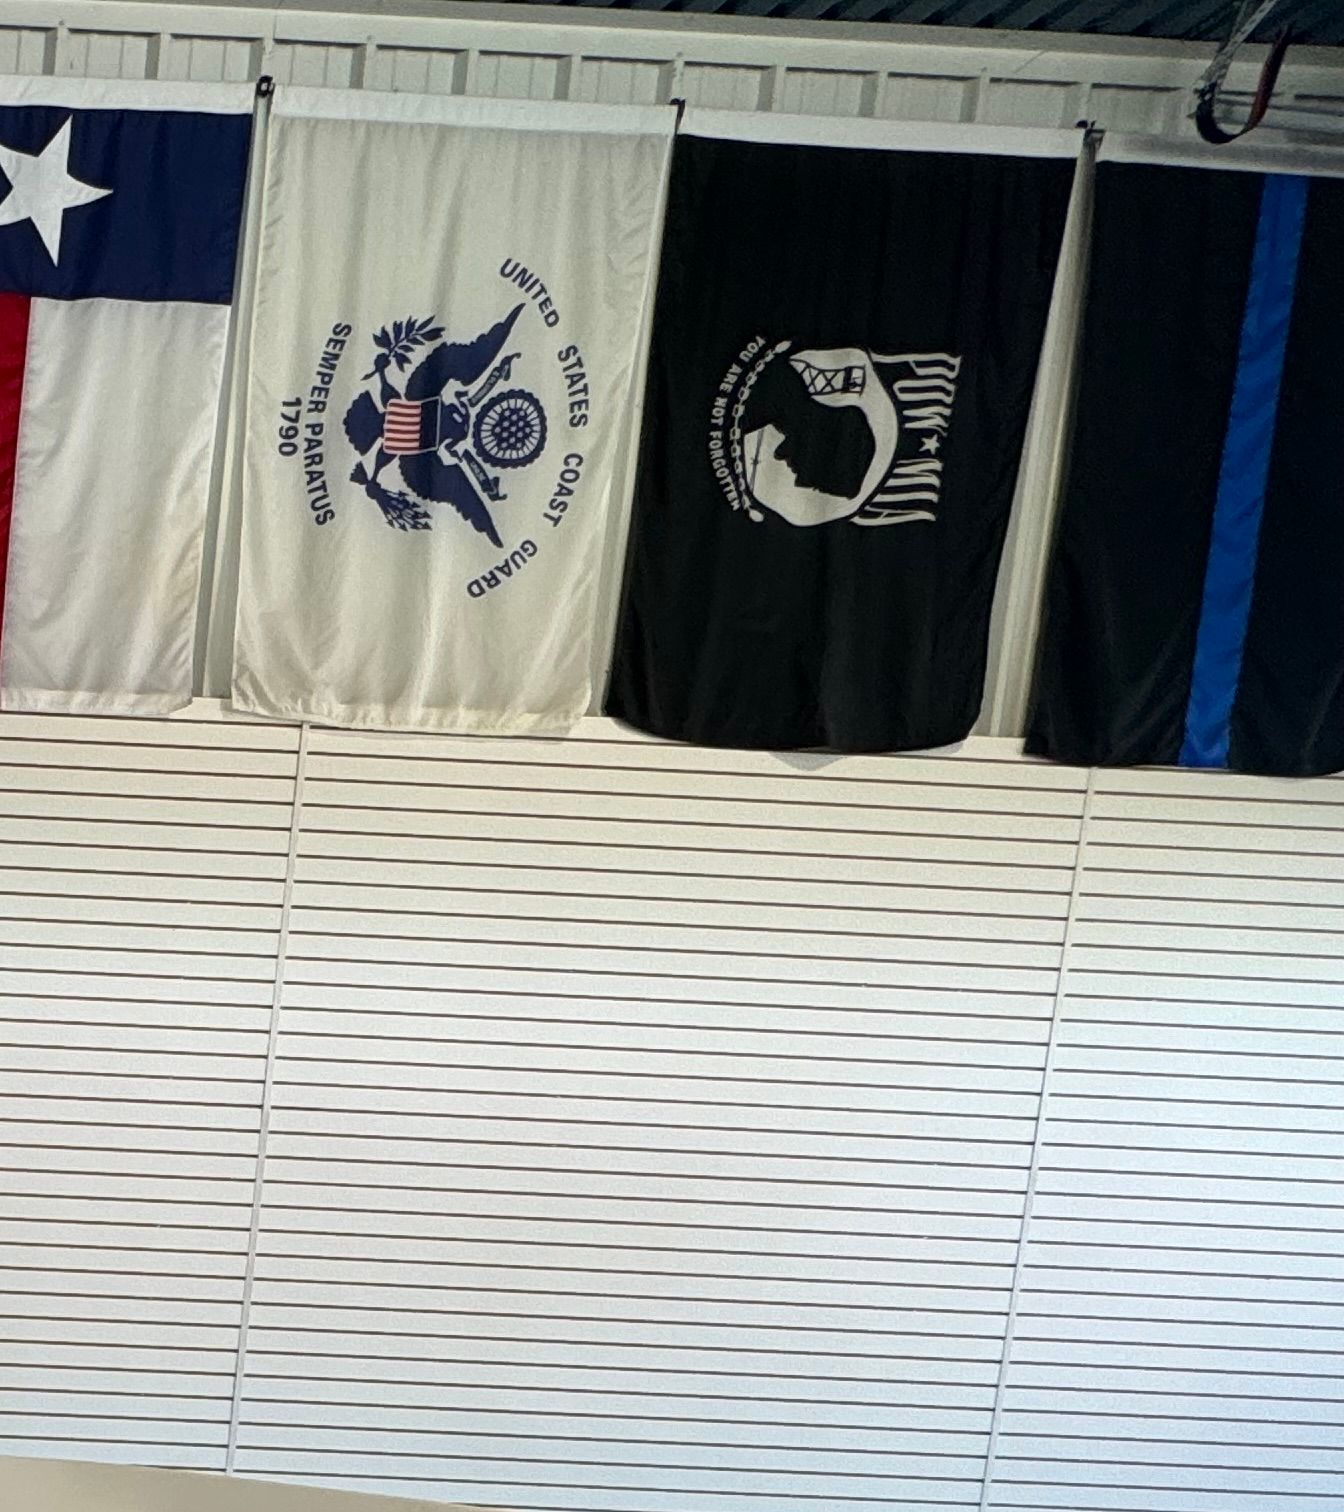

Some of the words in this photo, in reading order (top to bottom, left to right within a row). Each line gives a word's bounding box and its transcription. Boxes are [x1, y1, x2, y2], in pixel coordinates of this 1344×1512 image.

[499, 257, 560, 328] UNITED
[307, 321, 352, 415] SEMPER
[719, 362, 743, 394] ARE
[739, 335, 766, 363] YOU
[557, 344, 590, 429] STATES
[711, 396, 728, 427] NOT
[278, 396, 302, 458] 1790
[303, 422, 336, 527] PARATUS
[543, 452, 584, 528] COAST
[708, 430, 741, 512] FORGOTTEN
[466, 539, 538, 599] GUARD
